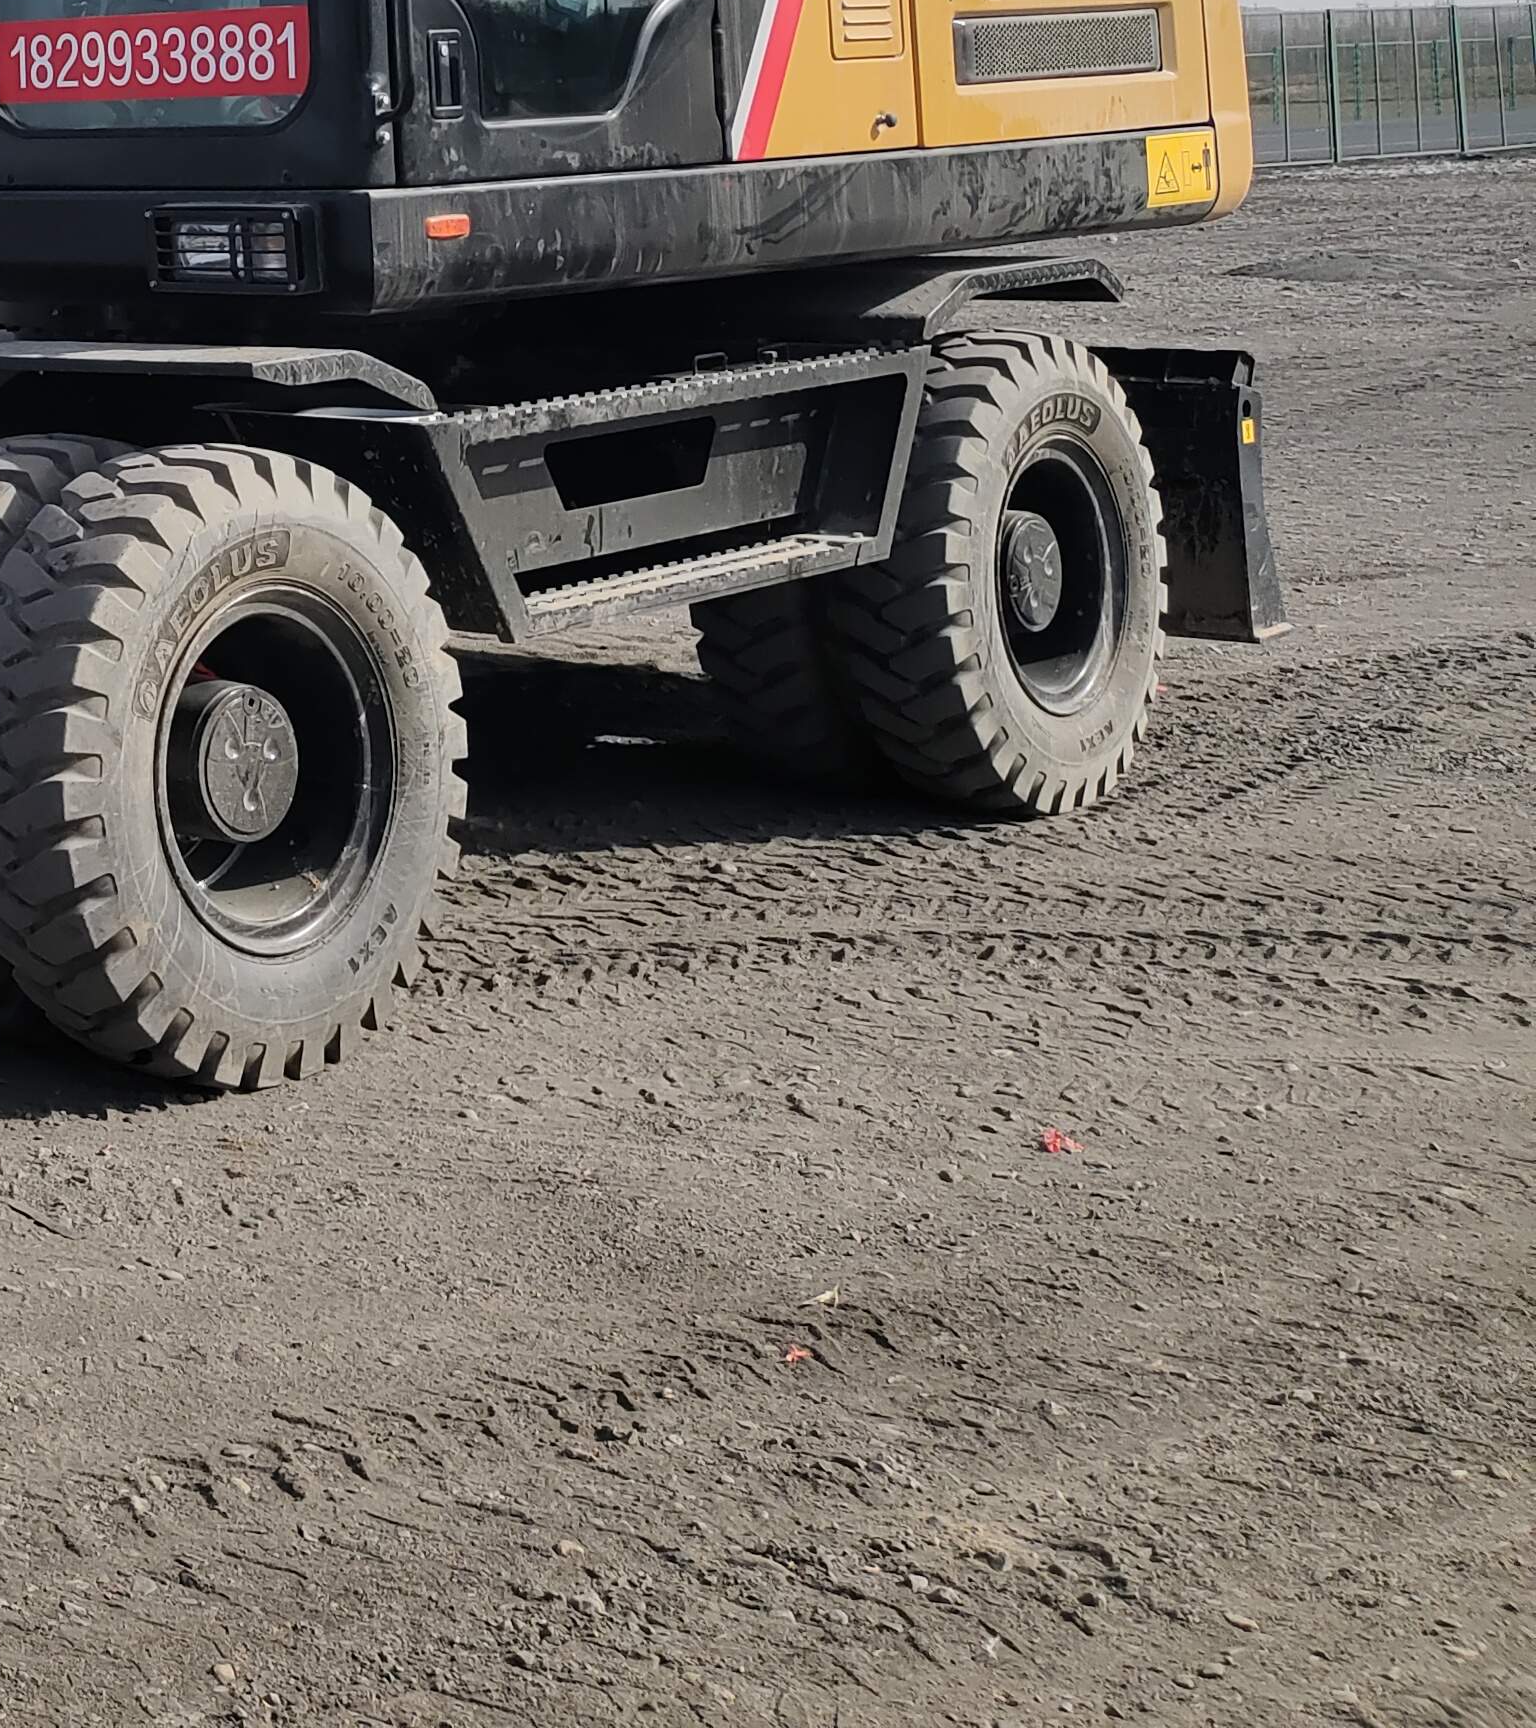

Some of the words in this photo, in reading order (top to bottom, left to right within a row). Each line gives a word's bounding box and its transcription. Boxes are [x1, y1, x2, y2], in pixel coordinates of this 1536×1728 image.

[9, 20, 297, 90] 18299338881
[1018, 396, 1096, 451] AEOLUS
[154, 538, 279, 676] AEOLUS
